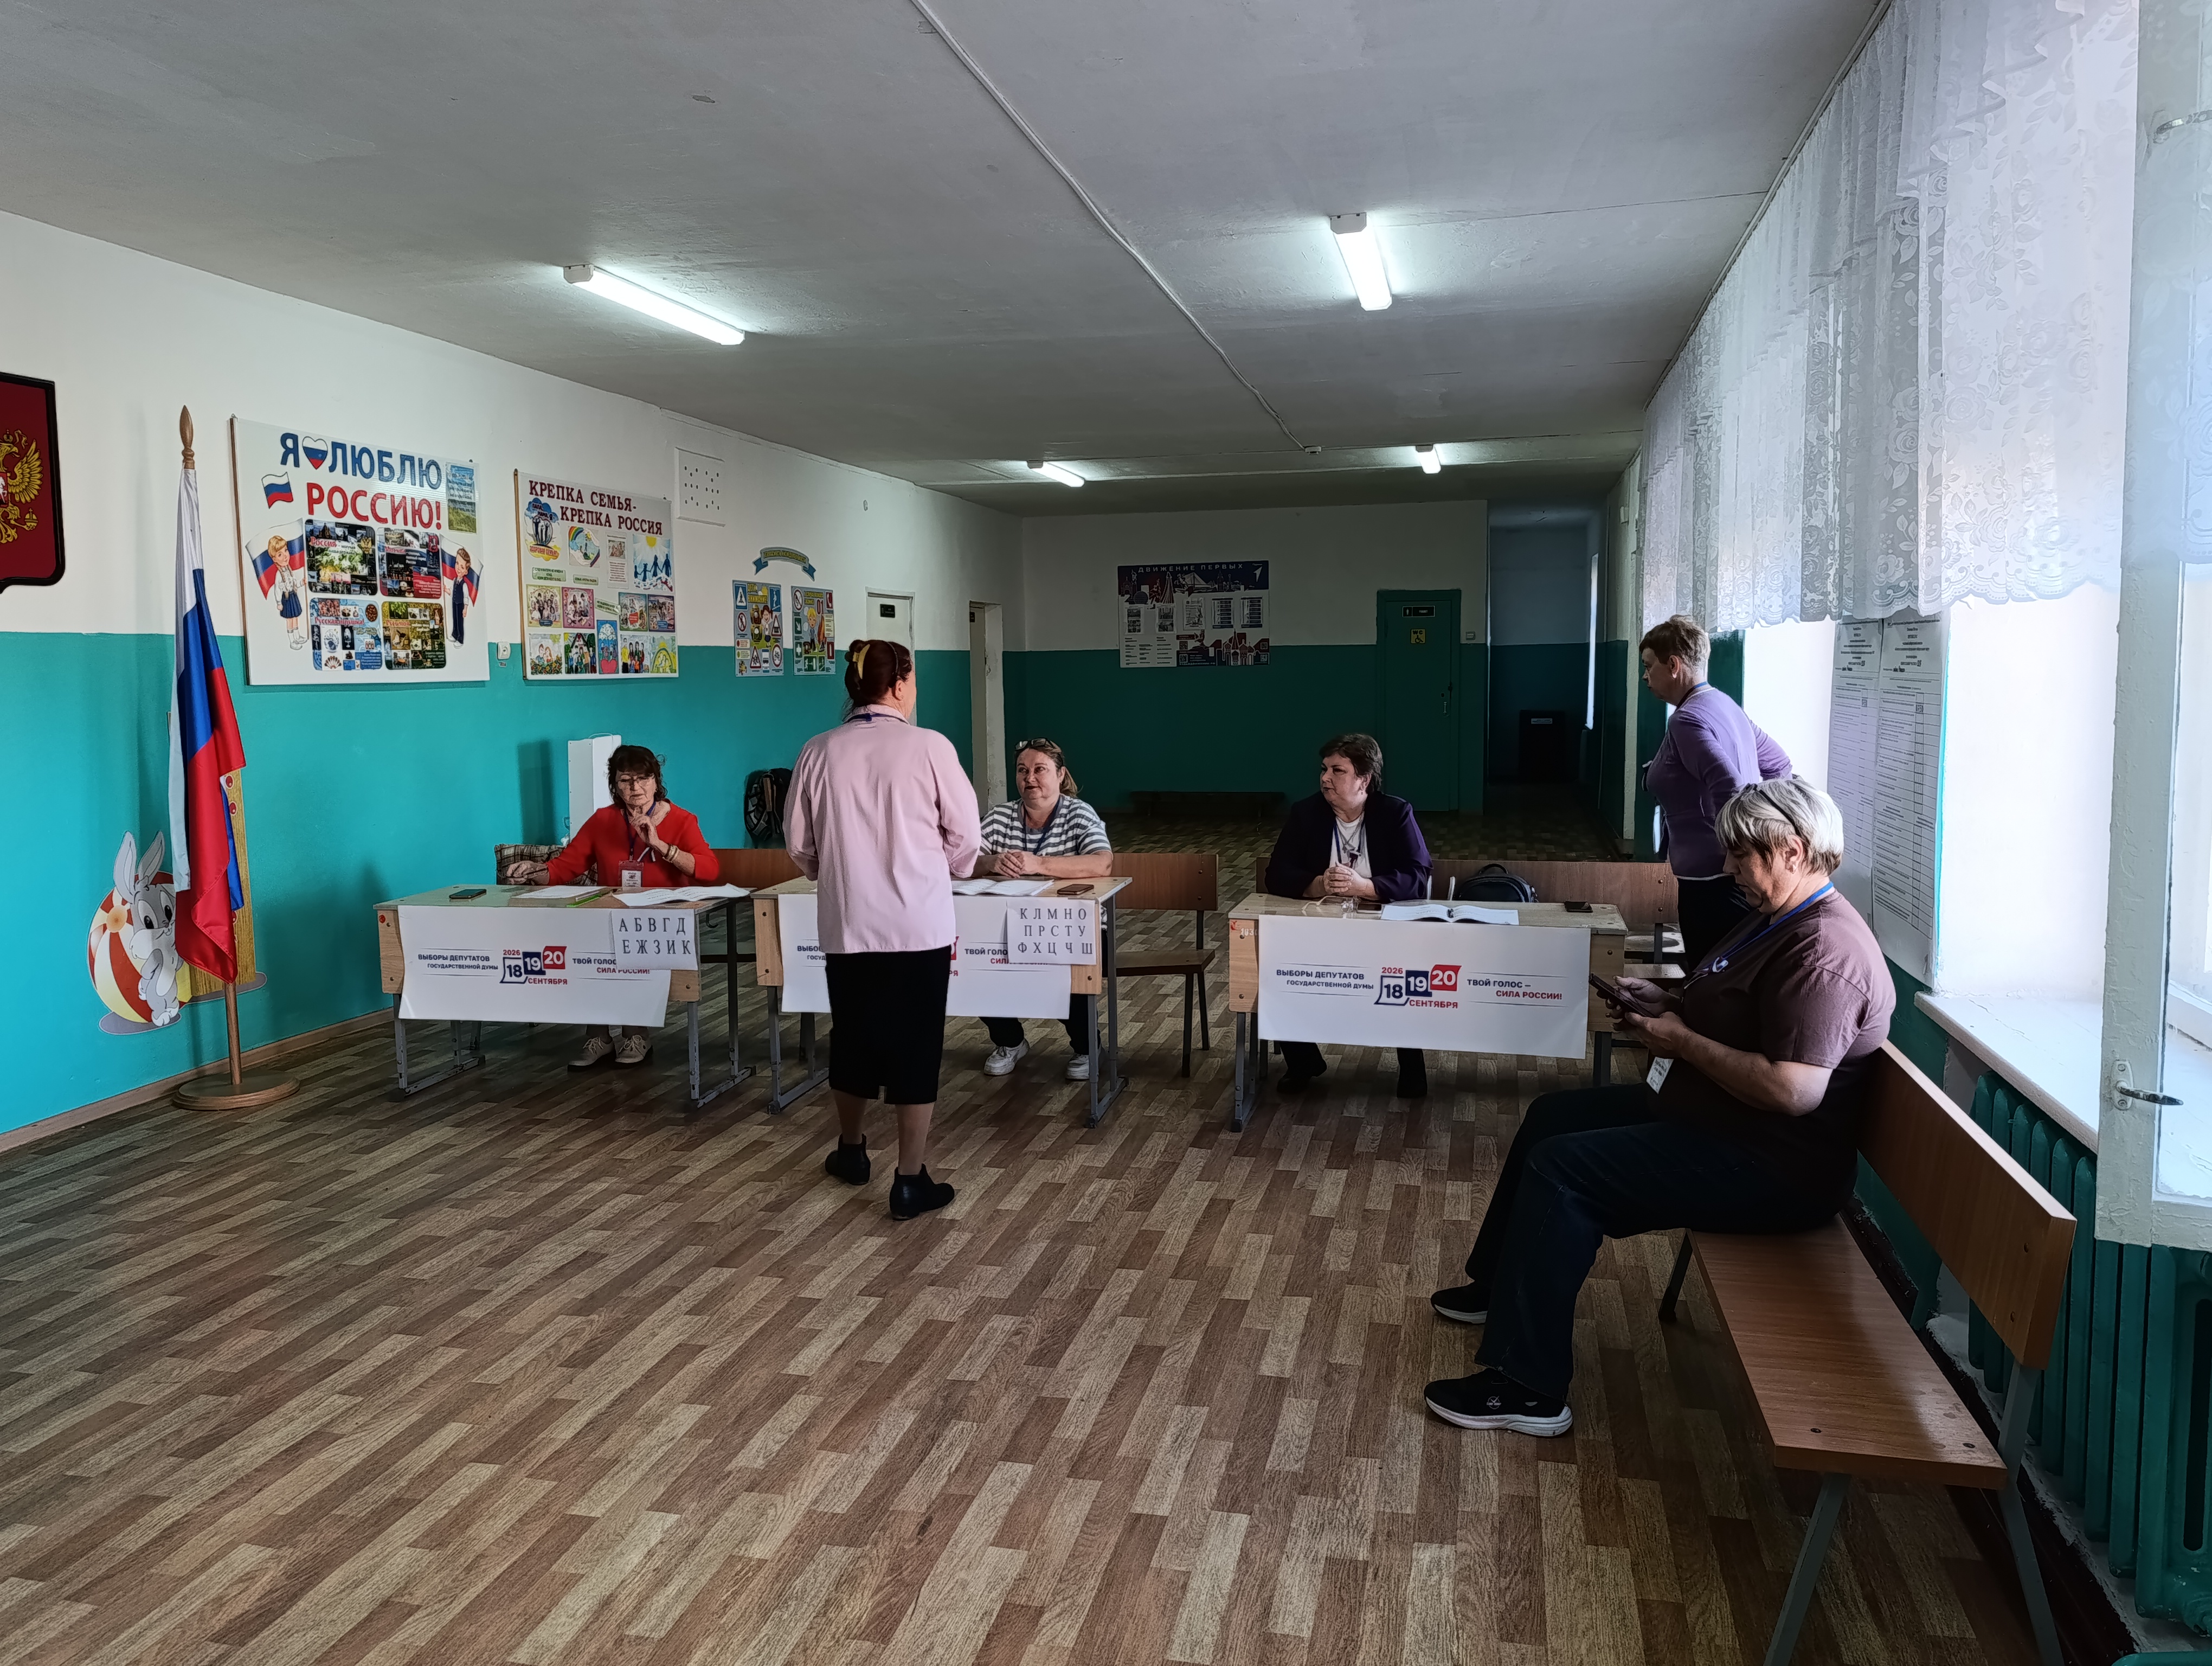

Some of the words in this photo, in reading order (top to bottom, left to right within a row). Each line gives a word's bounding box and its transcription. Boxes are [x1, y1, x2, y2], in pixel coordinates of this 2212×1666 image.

[280, 432, 300, 467] Я
[329, 441, 442, 489] ЛЮБЛЮ
[529, 480, 584, 504] КРЕПКА
[306, 482, 441, 530] РОССИЮ!
[560, 506, 612, 528] КРЕПКА
[618, 515, 663, 535] РОССИЯ
[817, 599, 824, 614] 01
[1020, 908, 1028, 919] К
[1033, 908, 1041, 919] Л
[1047, 908, 1058, 919] М
[1064, 908, 1072, 919] Н
[1078, 908, 1086, 920] О
[619, 918, 628, 932] А
[634, 918, 642, 932] Б
[648, 918, 657, 932] В
[663, 918, 670, 932] Г
[676, 918, 686, 936] Д
[1024, 925, 1032, 936] П
[1038, 925, 1045, 937] Р
[1051, 925, 1059, 937] С
[1065, 925, 1072, 937] Т
[1078, 925, 1086, 937] У
[622, 939, 631, 954] Е
[636, 939, 648, 954] Ж
[654, 940, 661, 954] З
[666, 940, 677, 954] И
[681, 940, 691, 954] К
[1018, 942, 1027, 953] Ф
[1033, 943, 1042, 953] Х
[1047, 943, 1057, 956] Ц
[1065, 943, 1073, 953] Ч
[1082, 943, 1093, 954] Ш
[506, 964, 523, 978] 18
[524, 957, 541, 971] 19
[543, 951, 564, 965] 20
[1276, 969, 1313, 977] ВЫБОРЫ
[1315, 971, 1364, 980] ДЕПУТАТОВ
[1467, 978, 1491, 986] ТВОЙ
[1287, 980, 1352, 988] ГОСУДАРСТВЕННОЙ
[1384, 984, 1403, 999] 18
[1408, 976, 1427, 992] 19
[1431, 970, 1456, 986] 20
[1522, 991, 1562, 999] РОССИИ!
[1409, 999, 1458, 1009] СЕНТЯБРЯ
